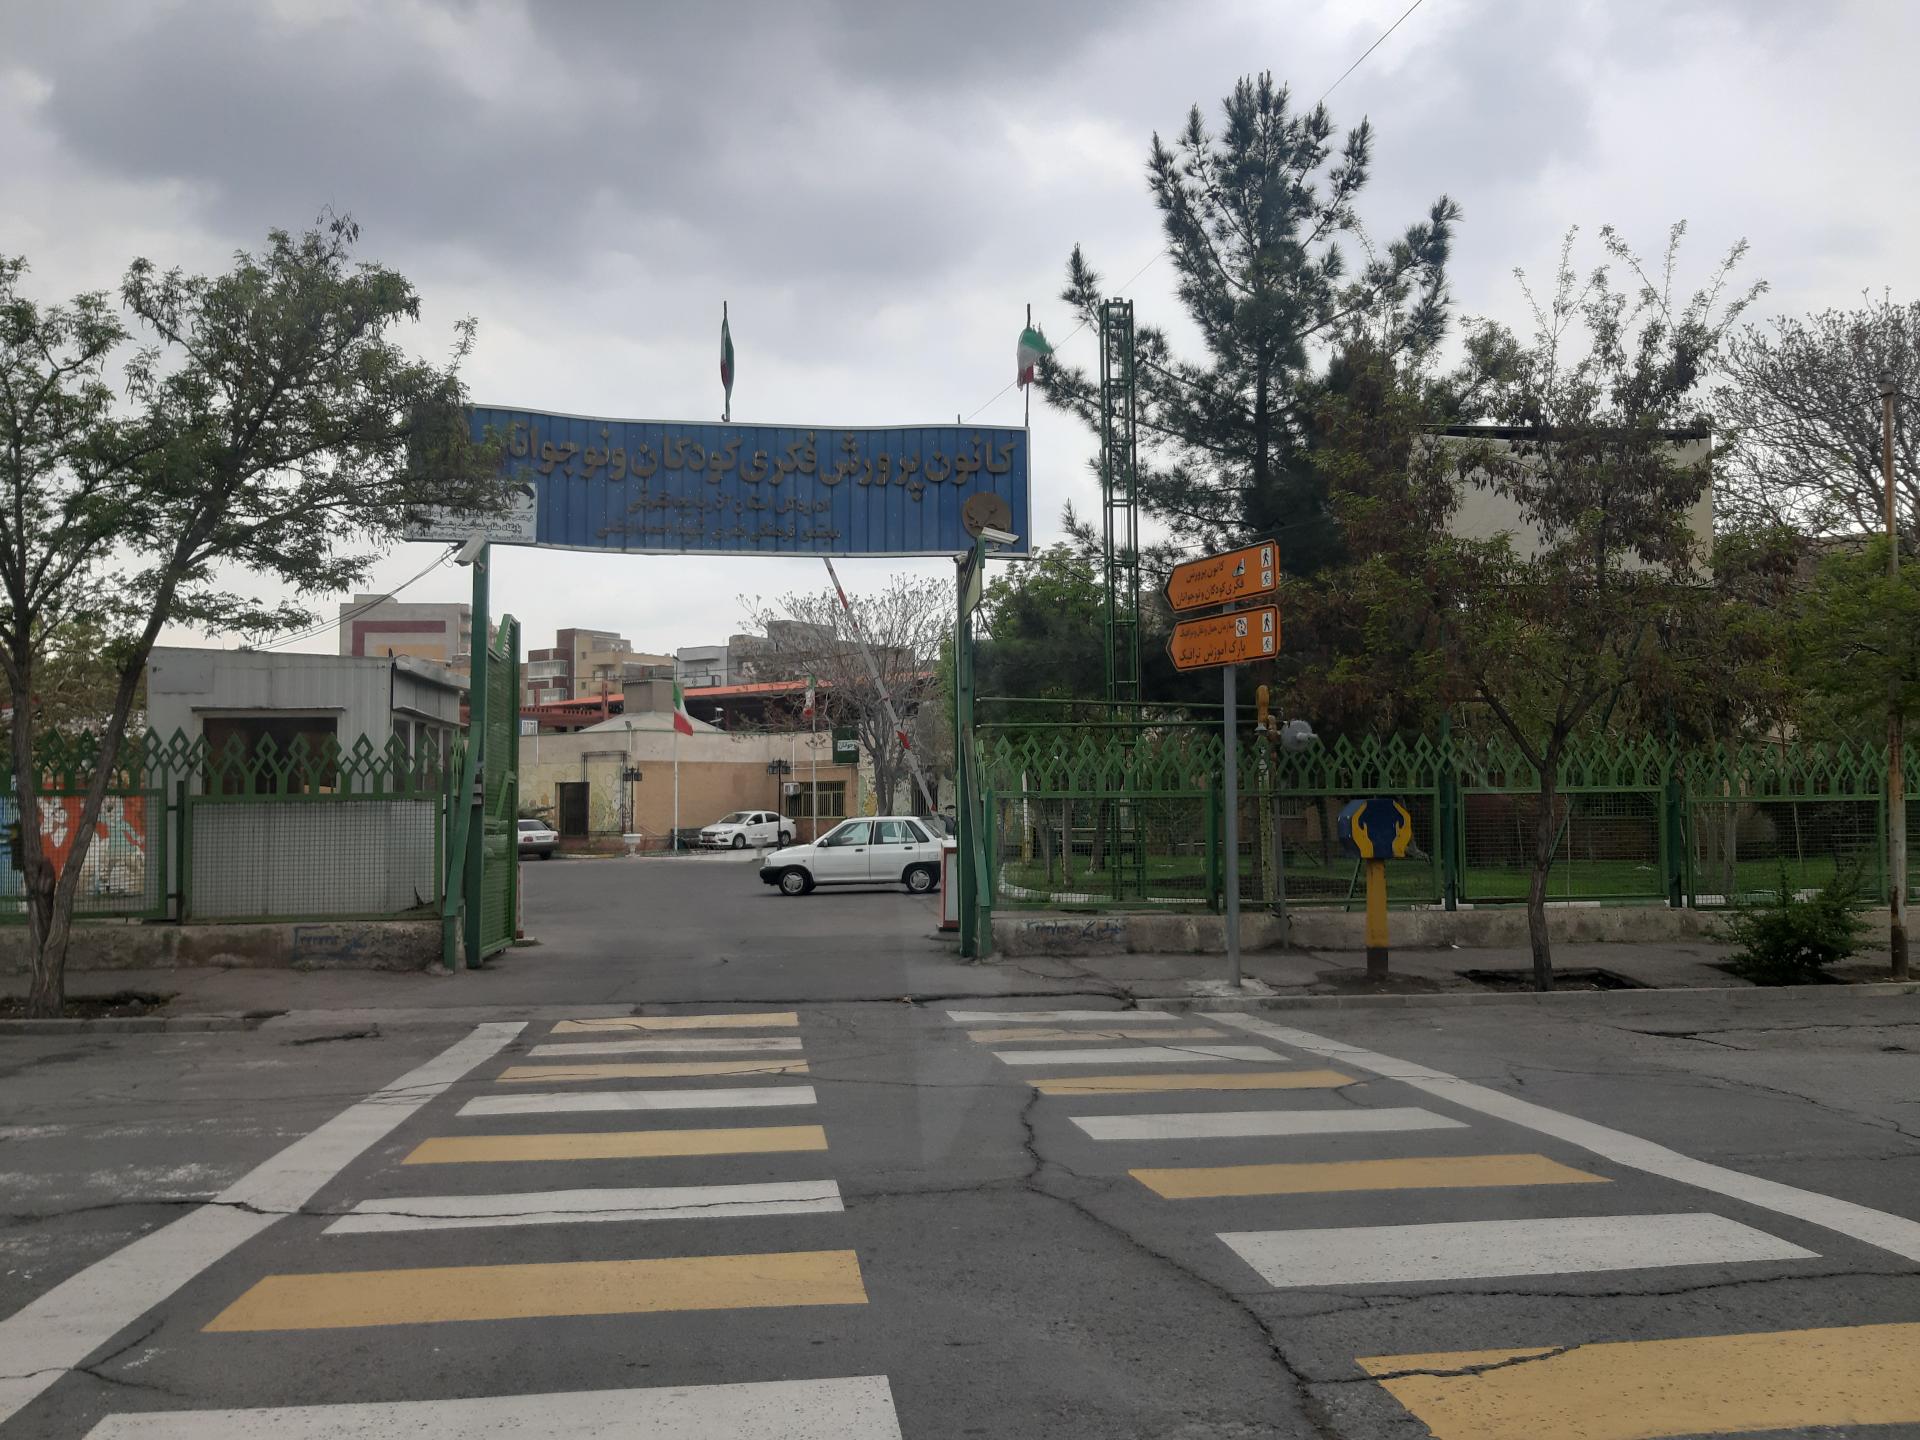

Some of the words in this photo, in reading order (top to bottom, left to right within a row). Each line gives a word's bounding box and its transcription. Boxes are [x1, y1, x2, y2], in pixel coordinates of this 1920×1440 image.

[631, 433, 744, 484] کودکان
[739, 431, 818, 486] فکری
[819, 432, 926, 502] پرورش
[924, 433, 1018, 485] کانون
[1207, 560, 1224, 578] کانون
[1205, 582, 1226, 600] کودکان
[1225, 578, 1244, 596] فکری
[1180, 647, 1201, 664] ترافیک
[1229, 639, 1246, 657] پارک
